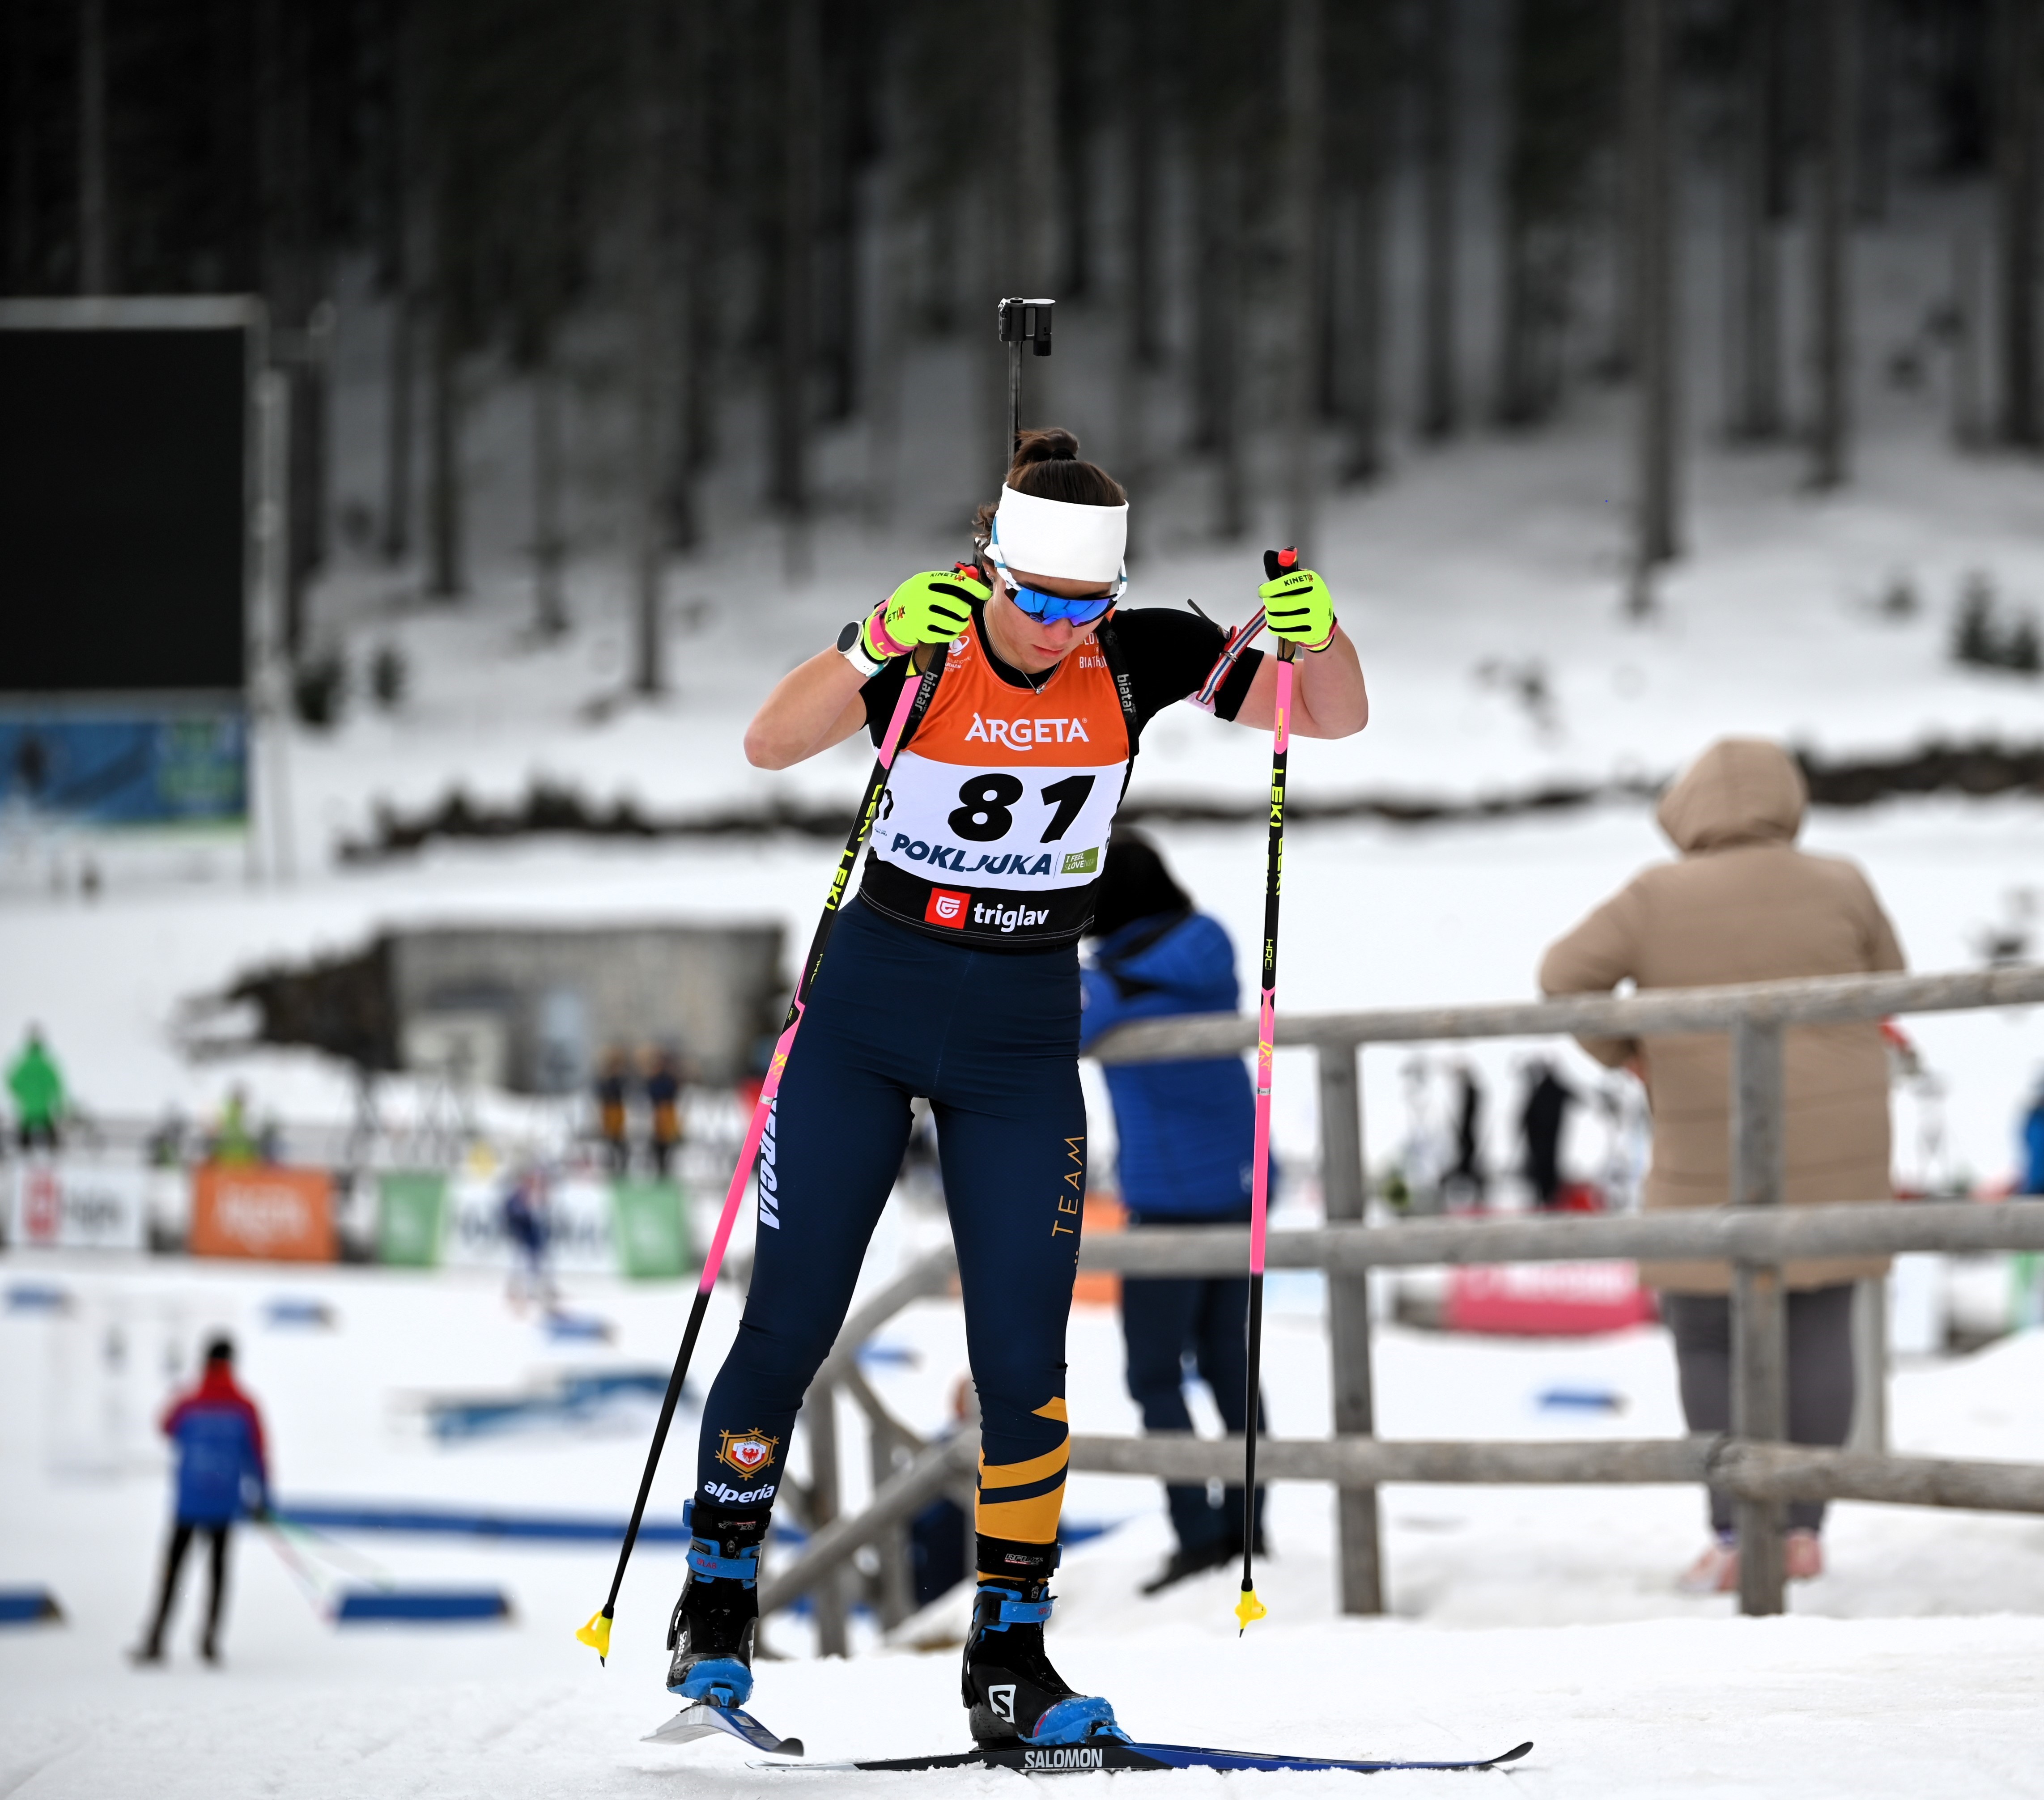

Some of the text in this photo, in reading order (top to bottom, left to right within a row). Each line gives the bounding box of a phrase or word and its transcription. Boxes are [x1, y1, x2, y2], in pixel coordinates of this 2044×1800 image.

[915, 671, 938, 711] biatar
[1117, 674, 1133, 713] biatar
[964, 712, 1089, 751] ARGETA
[948, 773, 1096, 844] 81
[1270, 768, 1284, 827] LEKI
[891, 833, 1052, 875] POKLJUKA
[1063, 858, 1094, 871] SLOVENIA
[1071, 853, 1084, 862] FEEL
[825, 849, 854, 910] LEKI
[973, 903, 1050, 932] triglav
[1265, 938, 1273, 968] HRC
[1051, 1136, 1084, 1237] TEAM
[704, 1481, 775, 1503] alperia
[1024, 1749, 1103, 1768] SALOMON
